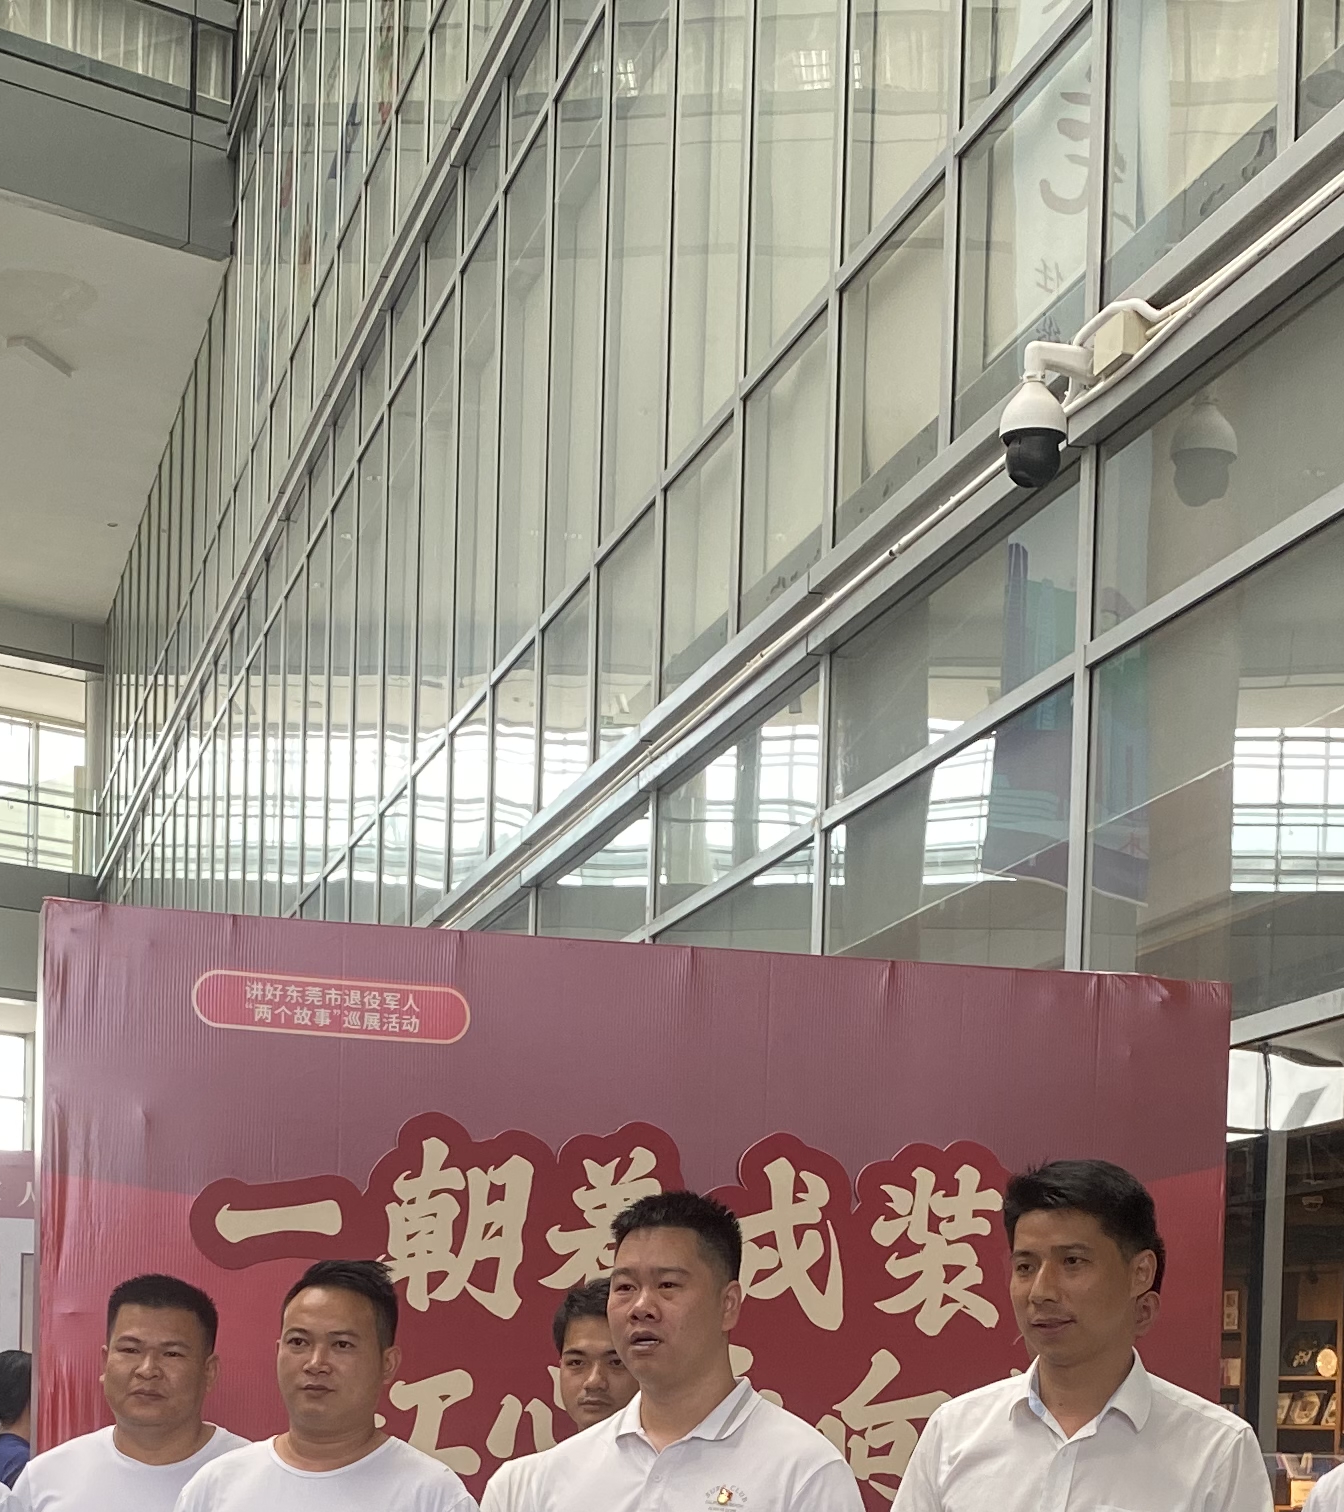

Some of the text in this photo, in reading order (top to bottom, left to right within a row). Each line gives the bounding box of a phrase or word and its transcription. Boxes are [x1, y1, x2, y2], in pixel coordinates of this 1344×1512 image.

[245, 981, 420, 1013] 讲好东莞市退役军人
